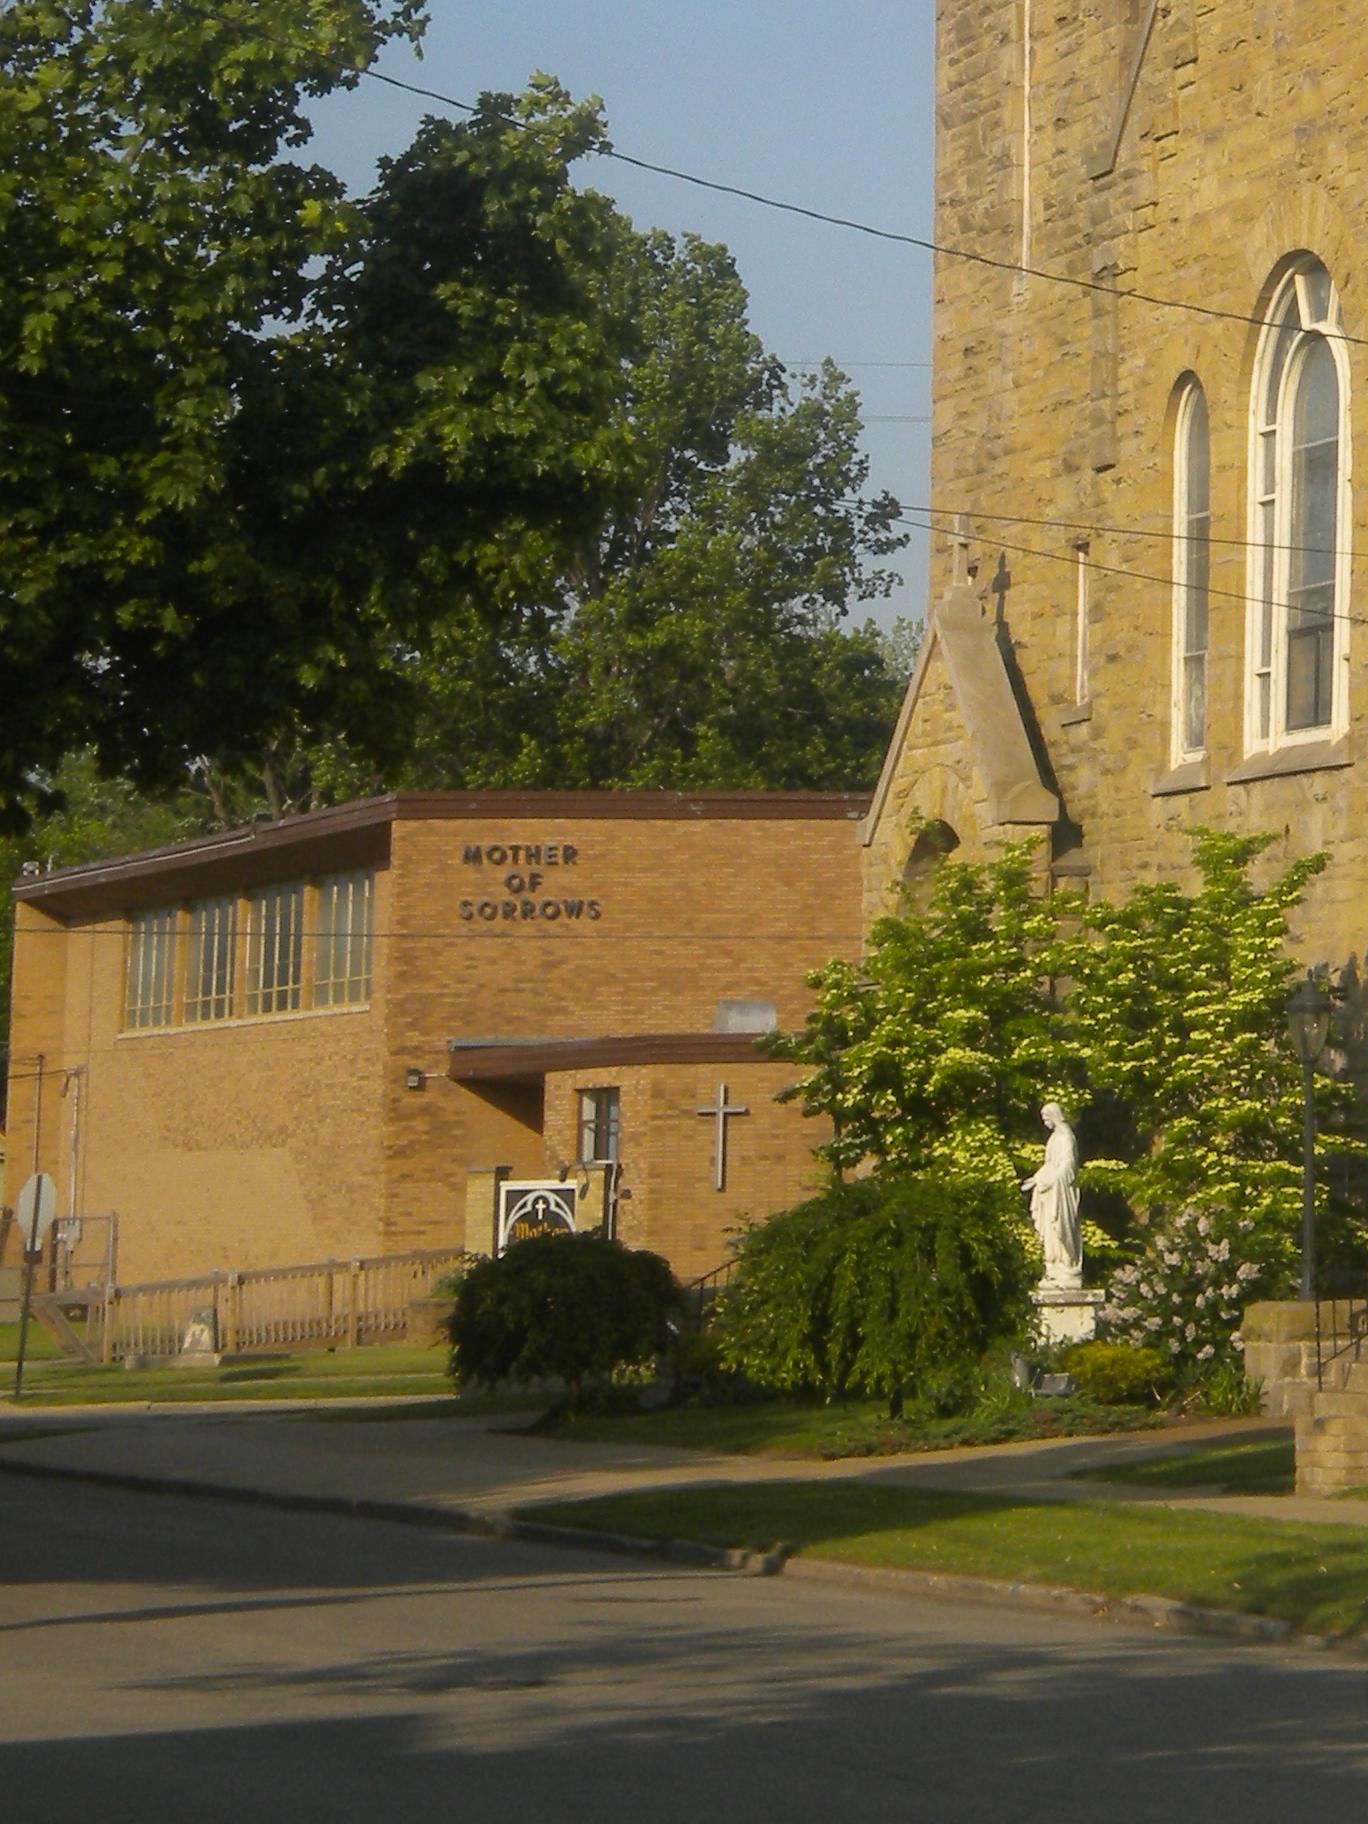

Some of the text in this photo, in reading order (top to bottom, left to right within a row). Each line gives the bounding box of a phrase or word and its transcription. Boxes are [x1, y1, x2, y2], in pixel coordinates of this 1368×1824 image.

[463, 844, 578, 865] MOTHER
[505, 871, 543, 893] OF
[460, 899, 601, 920] SORROWS
